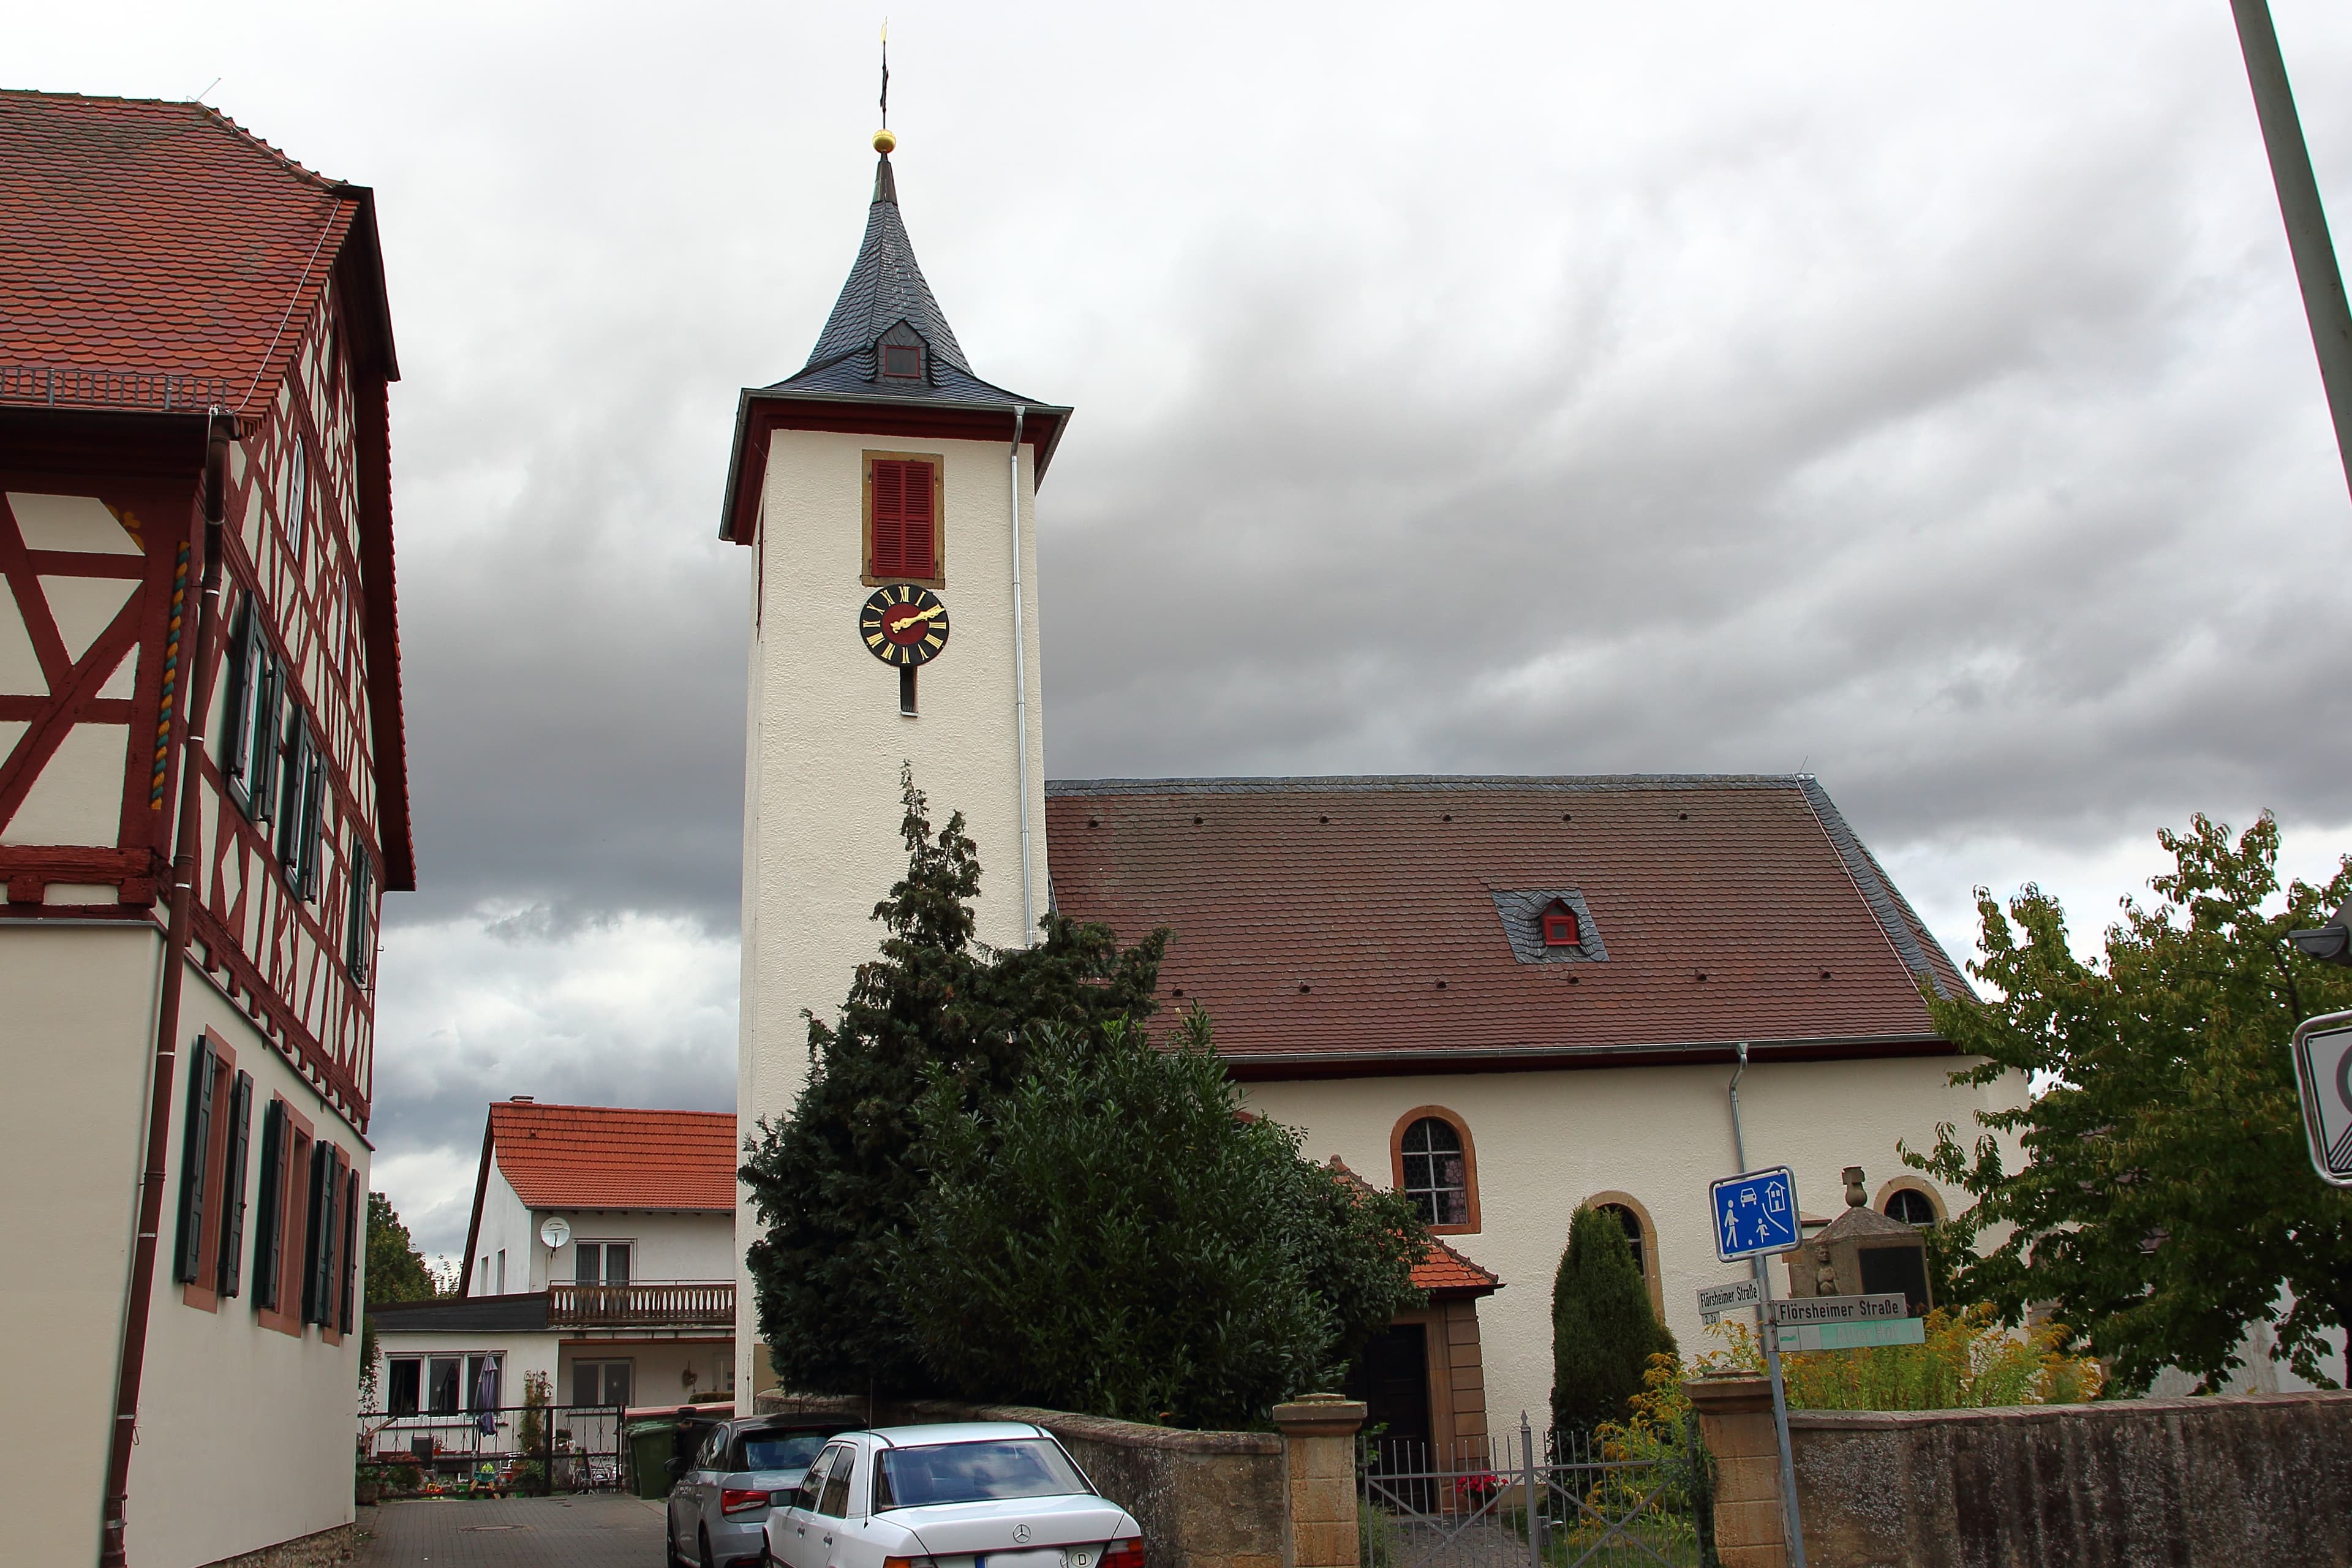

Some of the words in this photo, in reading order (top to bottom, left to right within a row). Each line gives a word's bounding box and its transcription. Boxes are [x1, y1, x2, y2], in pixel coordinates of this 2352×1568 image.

[899, 586, 910, 603] XII
[915, 591, 926, 606] I
[1700, 1290, 1735, 1308] Flörsheimer
[1736, 1284, 1758, 1301] Straße
[1779, 1303, 1854, 1320] Flörsheimer
[1860, 1299, 1899, 1316] Straße
[1837, 1324, 1871, 1344] Alter
[1874, 1322, 1898, 1342] Hof
[1078, 1554, 1087, 1566] D
